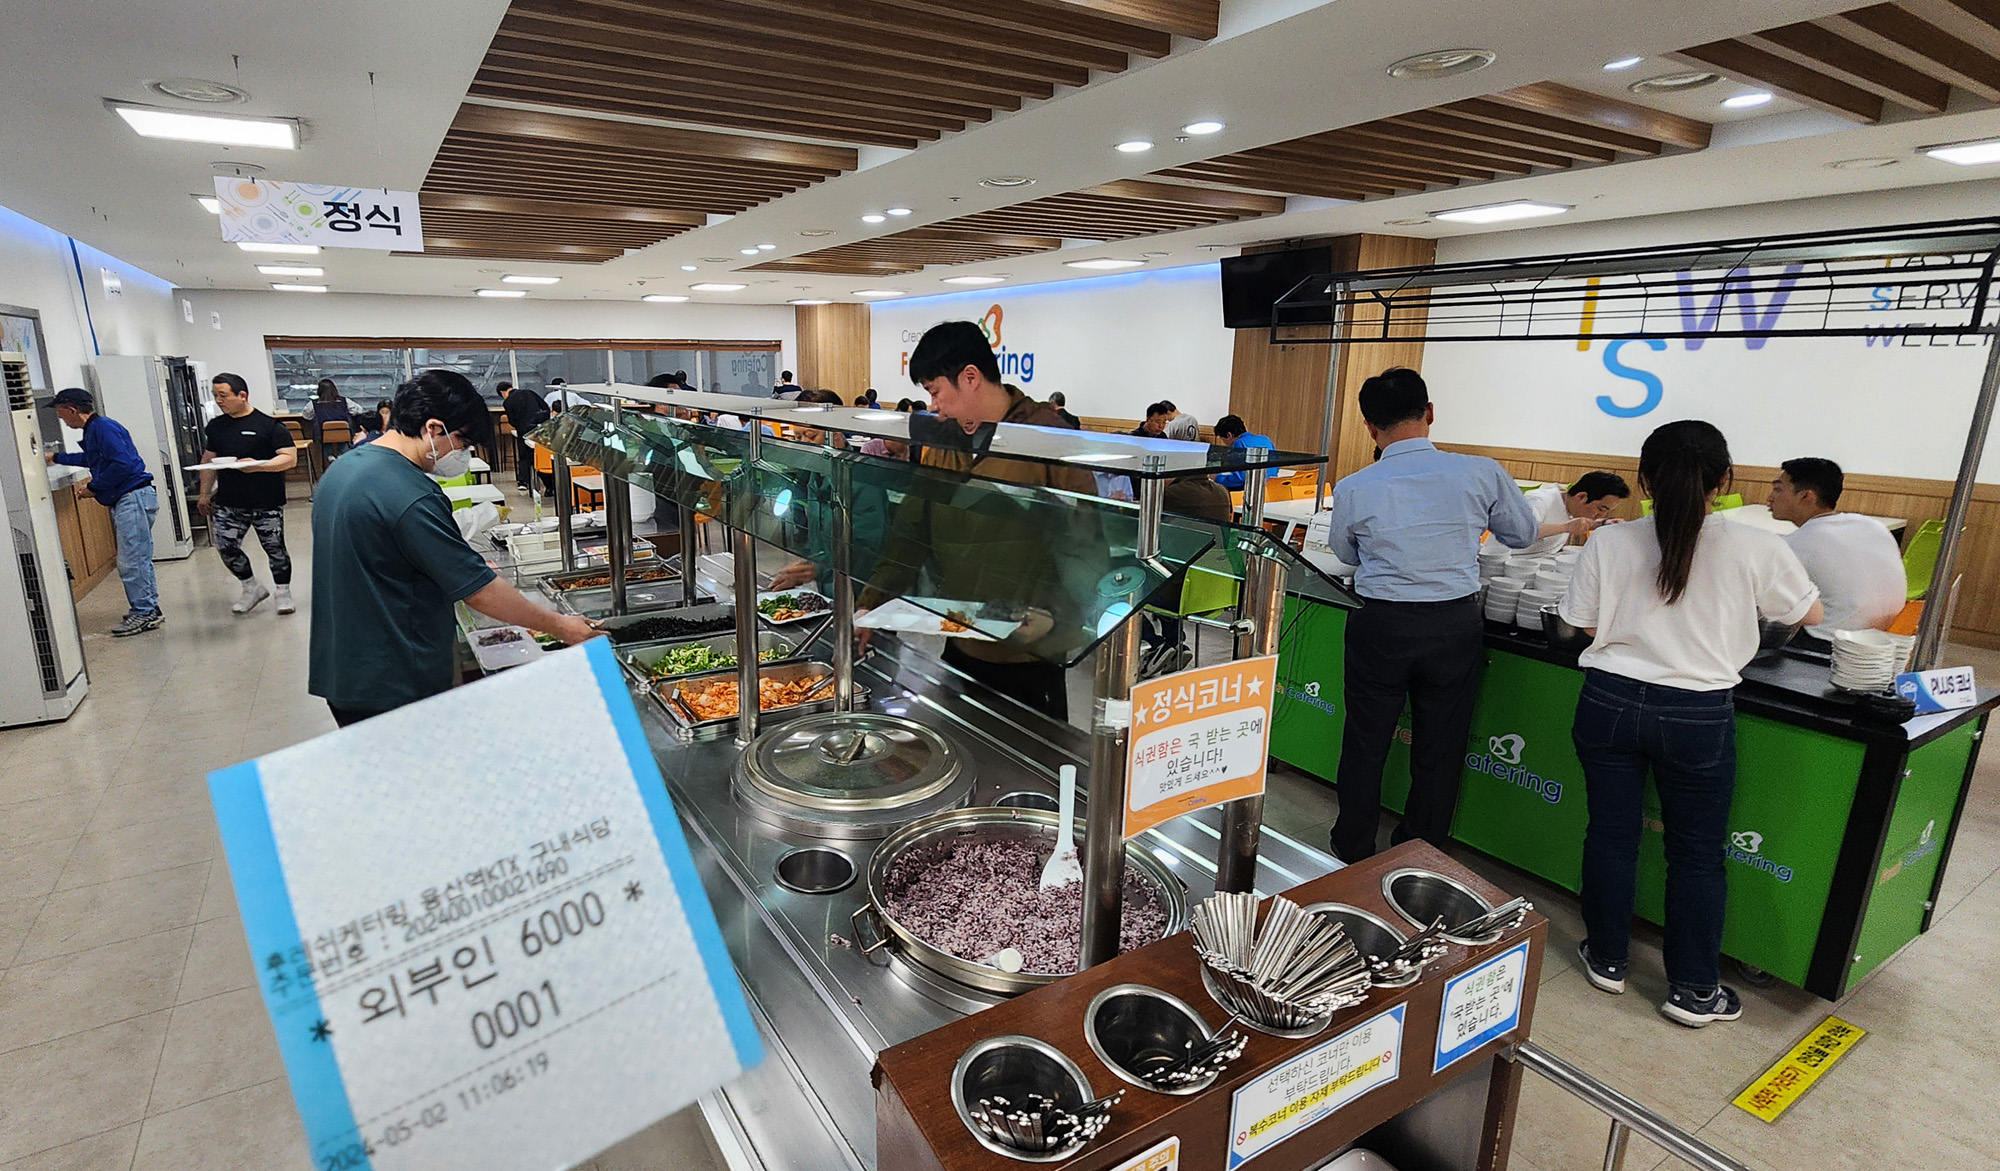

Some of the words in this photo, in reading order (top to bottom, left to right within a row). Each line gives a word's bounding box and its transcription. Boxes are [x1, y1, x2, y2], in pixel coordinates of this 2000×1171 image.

[323, 201, 402, 237] 정식
[1676, 264, 1803, 351] W
[1596, 332, 1667, 418] S
[1152, 674, 1243, 724] 정식코너
[1286, 686, 1336, 716] Catering
[1135, 737, 1183, 767] 식권함은
[1188, 732, 1201, 749] 국
[1206, 727, 1231, 746] 받는
[1237, 717, 1263, 739] 곳에
[1167, 748, 1223, 777] 있습니다!
[1159, 777, 1182, 794] 맛있게
[1465, 752, 1563, 804] atering
[420, 855, 520, 911] 용산역KTX
[530, 815, 611, 863] 구내식당
[1724, 843, 1793, 883] tering
[358, 936, 498, 1023] 외부인
[521, 892, 605, 957] 6000
[1465, 965, 1506, 996] 식권함은
[471, 980, 561, 1050] 0001
[1457, 1003, 1502, 1040] 있습니다.
[1268, 1058, 1314, 1093] 선택하신
[1317, 1039, 1350, 1067] 코너만
[1352, 1028, 1372, 1047] 이용
[1284, 1056, 1353, 1101] 부탁드립니다.
[322, 1102, 447, 1171] 2024-05-02
[458, 1051, 550, 1110] 11:06:19
[1249, 1107, 1287, 1136] 복수코너
[1289, 1096, 1308, 1114] 이용
[1310, 1085, 1329, 1103] 자제
[1330, 1055, 1381, 1092] 부탁드립니다
